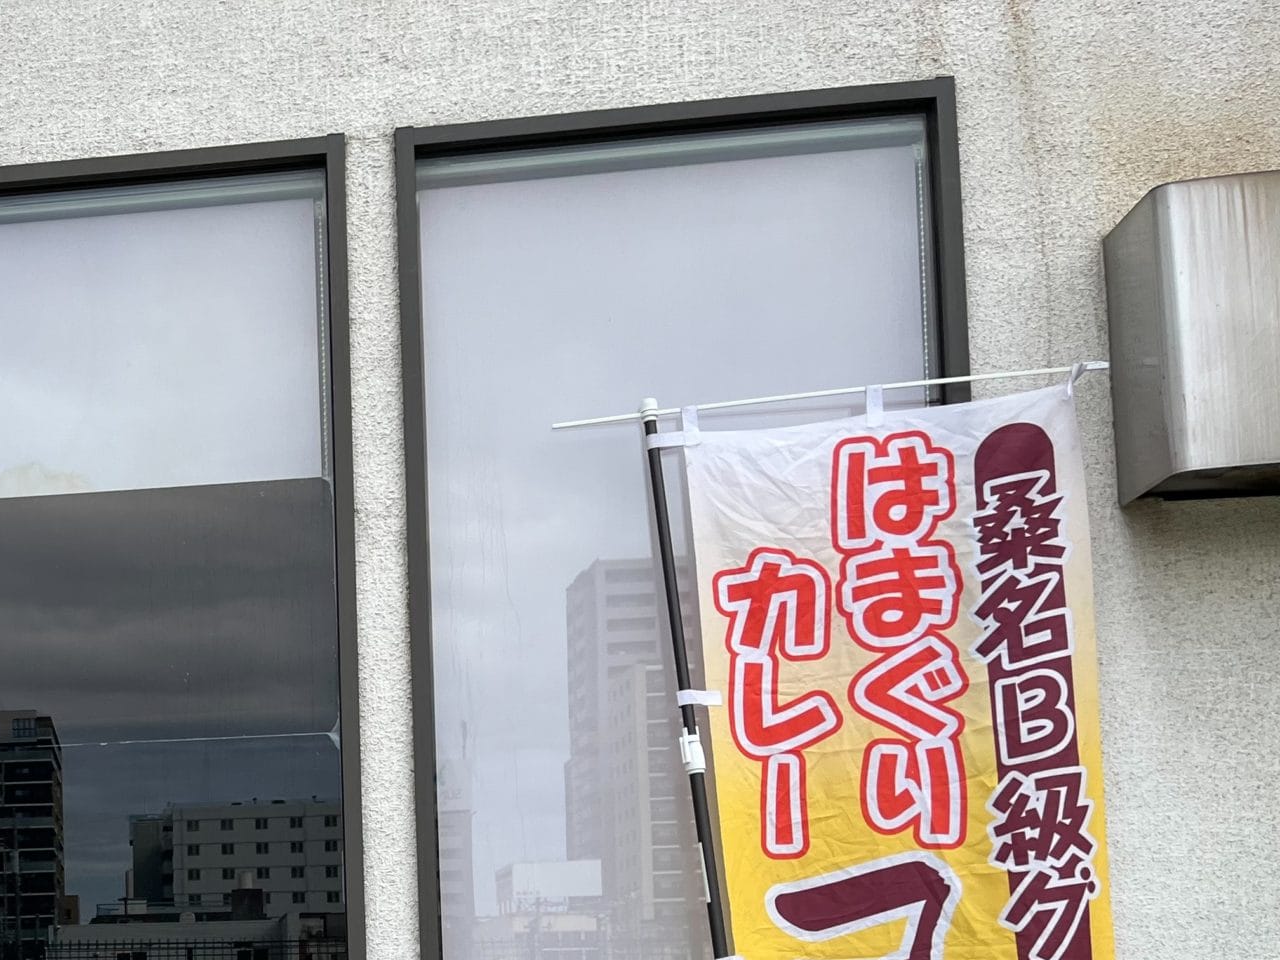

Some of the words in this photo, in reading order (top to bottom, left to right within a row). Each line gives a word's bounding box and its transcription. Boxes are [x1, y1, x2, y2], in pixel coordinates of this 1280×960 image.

[713, 548, 839, 859] カレー
[832, 431, 968, 849] はまぐり
